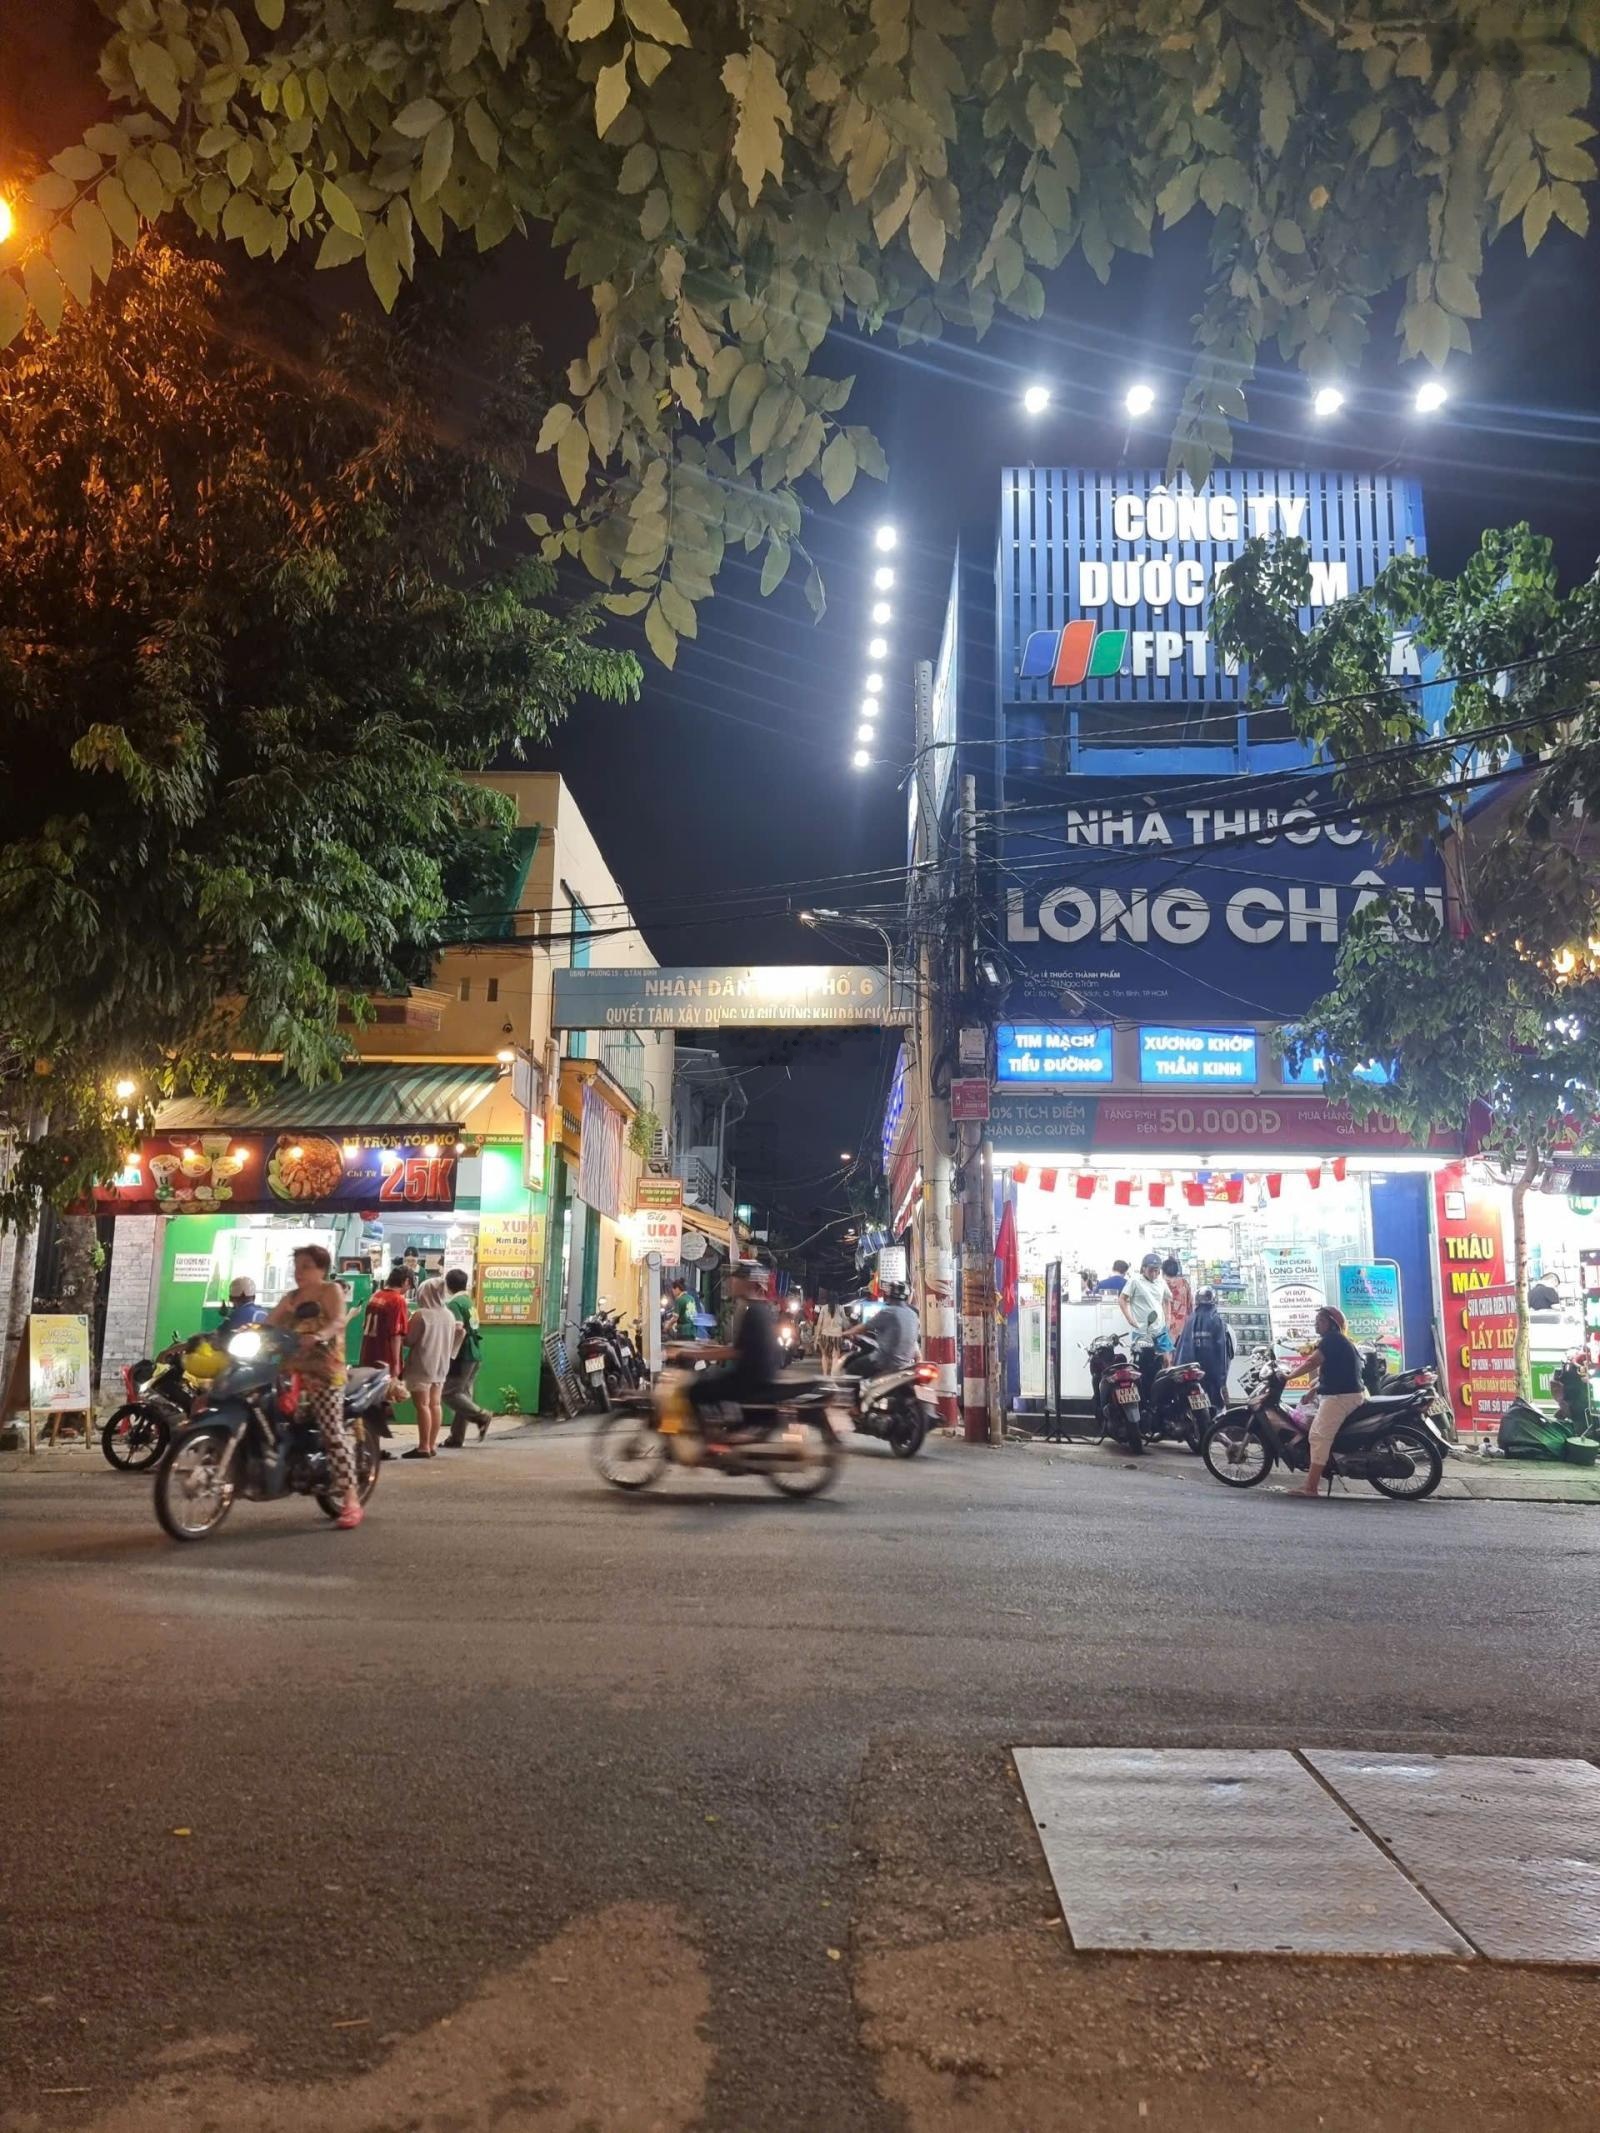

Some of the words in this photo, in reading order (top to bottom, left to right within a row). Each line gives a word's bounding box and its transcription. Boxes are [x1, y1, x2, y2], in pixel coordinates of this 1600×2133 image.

[1113, 486, 1239, 542] CÔNG
[1241, 497, 1307, 541] TY
[1079, 553, 1205, 616] DƯỢC
[1131, 630, 1209, 677] FPT
[1067, 796, 1174, 846] NHÀ
[1186, 790, 1368, 846] THUỐC
[1006, 886, 1210, 944] LONG
[1226, 869, 1444, 944] CHÂU
[645, 976, 701, 997] NHÂN
[707, 976, 751, 997] DÂN
[860, 978, 874, 996] 6
[606, 1001, 645, 1024] QUYẾT
[648, 1004, 674, 1023] TÂM
[679, 1004, 702, 1023] XÂY
[1015, 1034, 1041, 1048] TIM
[1046, 1034, 1095, 1051] MẠCH
[1144, 1036, 1205, 1051] XƯƠNG
[1207, 1034, 1255, 1052] KHỚP
[1008, 1052, 1040, 1072] TIỂU
[1043, 1055, 1104, 1073] ĐƯỜNG
[1203, 1061, 1242, 1076] KINH
[1016, 1103, 1048, 1120] TÍCH
[1052, 1102, 1086, 1119] ĐIỂM
[1104, 1109, 1127, 1122] TẶNG
[1298, 1111, 1321, 1121] MUA
[1322, 1109, 1353, 1122] HÀNG
[1015, 1122, 1042, 1138] ĐẶC
[1044, 1122, 1086, 1137] QUYỀN
[1136, 1120, 1158, 1133] ĐẾN
[1160, 1108, 1282, 1134] 50.000Đ
[363, 1134, 400, 1151] TRỘN
[404, 1134, 430, 1146] TÓP
[434, 1133, 456, 1147] MỠ
[379, 1157, 455, 1203] 25K
[642, 1223, 678, 1237] UKA
[495, 1236, 511, 1244] Kim
[512, 1236, 527, 1246] Bap
[1445, 1233, 1495, 1261] THÂU
[1269, 1267, 1293, 1275] LONG
[1295, 1264, 1318, 1274] CHÂU
[1345, 1286, 1370, 1294] LONG
[1451, 1271, 1492, 1294] MÁY
[1471, 1321, 1494, 1350] LẤY
[1478, 1399, 1491, 1412] SIM
